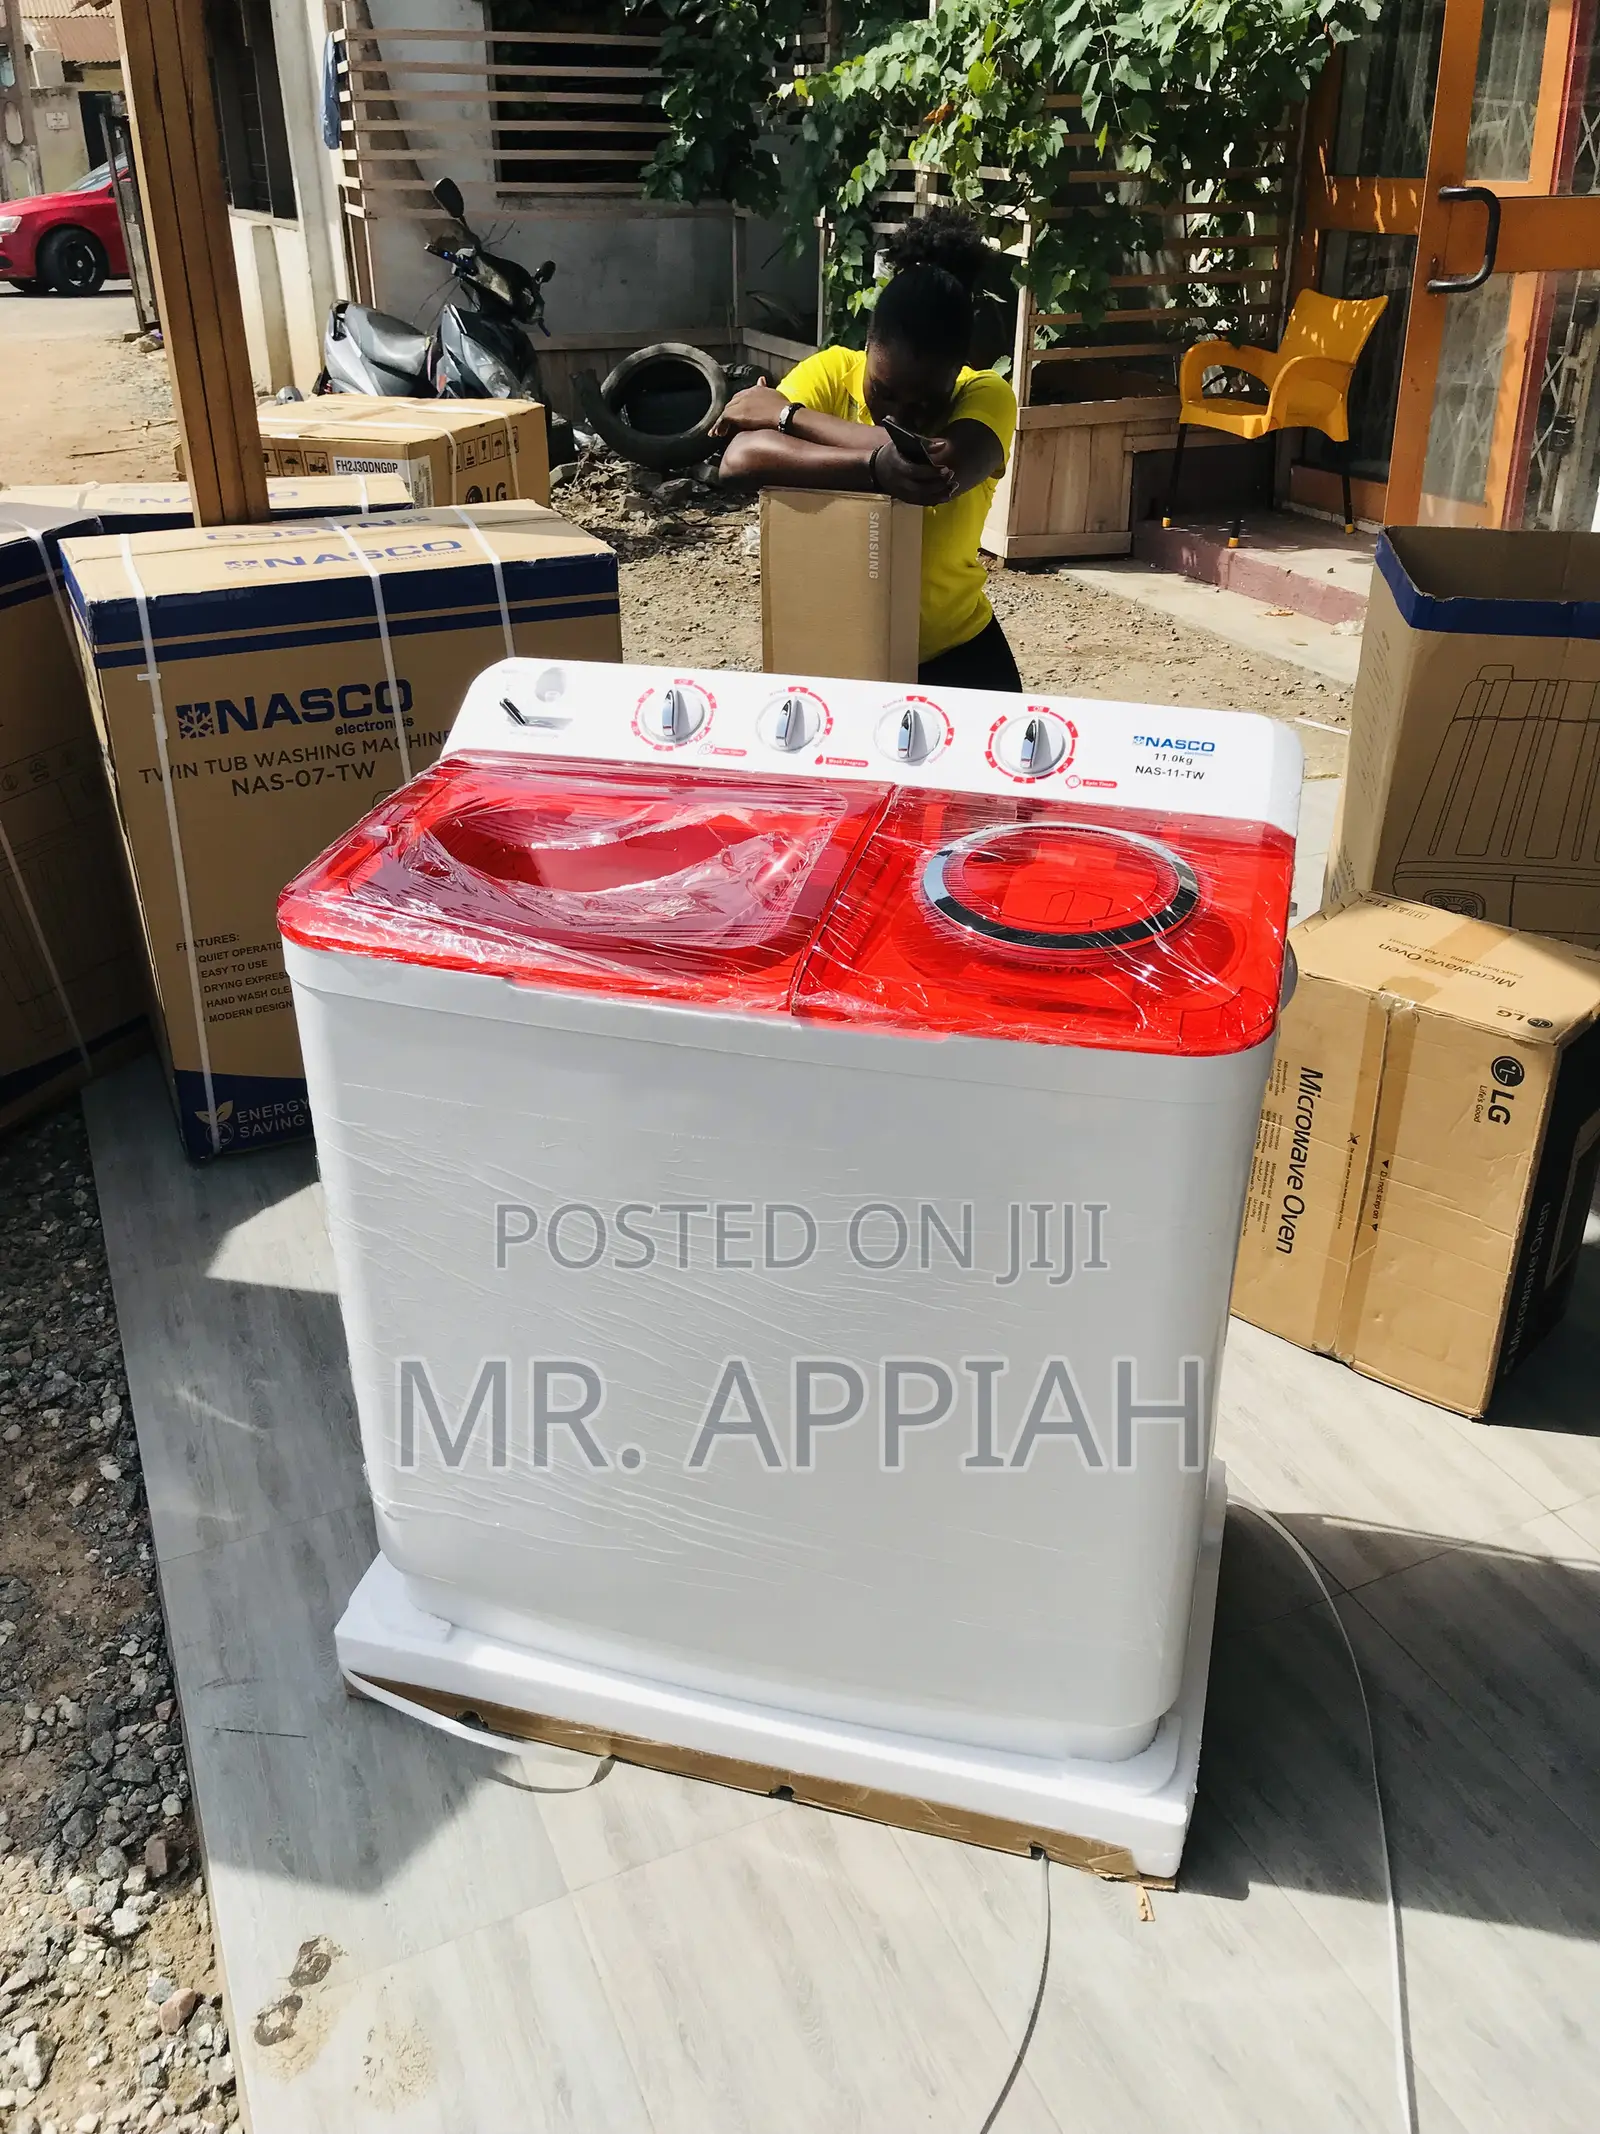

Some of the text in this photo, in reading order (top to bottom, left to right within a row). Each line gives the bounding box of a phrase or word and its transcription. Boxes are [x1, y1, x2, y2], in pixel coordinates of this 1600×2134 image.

[264, 540, 462, 568] NASCO
[869, 511, 879, 579] SAMSUNG
[215, 679, 413, 734] NASCO
[335, 716, 414, 736] electronis
[1145, 737, 1215, 752] NASCO
[139, 762, 198, 783] TWIN
[204, 756, 247, 775] TUB
[254, 742, 355, 768] WASHING
[1155, 753, 1193, 765] 11.0kg
[231, 760, 375, 796] NAS-07-TW
[1135, 765, 1205, 780] NAS-11-TW
[198, 951, 229, 963] QUIET
[201, 959, 268, 978] EASY TO USE
[1378, 943, 1516, 988] Microwave Oven
[204, 971, 289, 993] DRYING EXPRES
[206, 985, 292, 1008] HAND WASH CLE
[209, 1000, 292, 1022] MODERN DESIGN
[1496, 1009, 1528, 1022] LG
[236, 1098, 309, 1123] ENERGY
[1474, 1084, 1487, 1123] Life's Good
[1488, 1089, 1515, 1125] LG
[240, 1114, 305, 1138] SAVING
[1276, 1066, 1323, 1254] Microwave Oven
[1507, 1202, 1550, 1355] Microwave Oven
